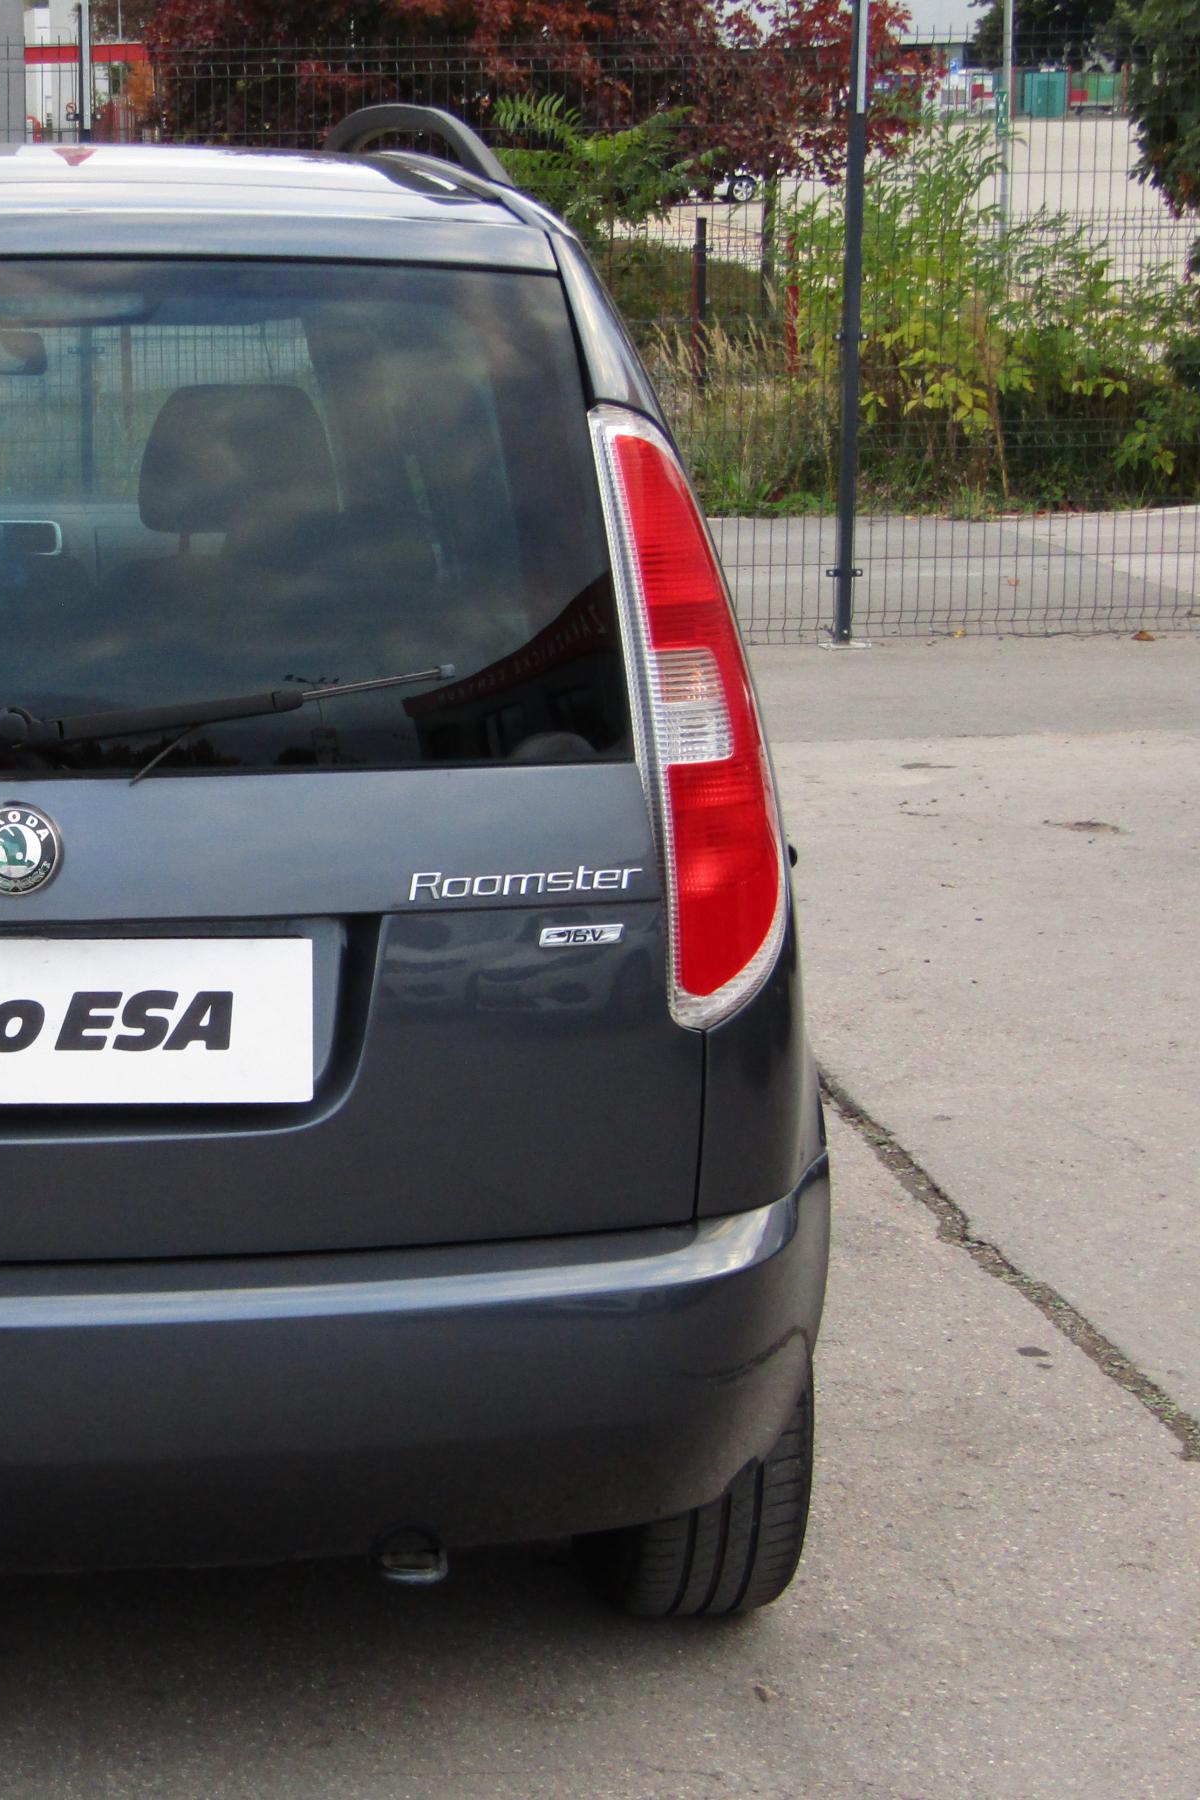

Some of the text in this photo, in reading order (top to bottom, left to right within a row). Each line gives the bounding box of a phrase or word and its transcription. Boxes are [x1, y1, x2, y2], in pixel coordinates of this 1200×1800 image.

[408, 865, 643, 901] Roomster
[564, 928, 604, 943] 16V
[54, 990, 233, 1051] ESA
